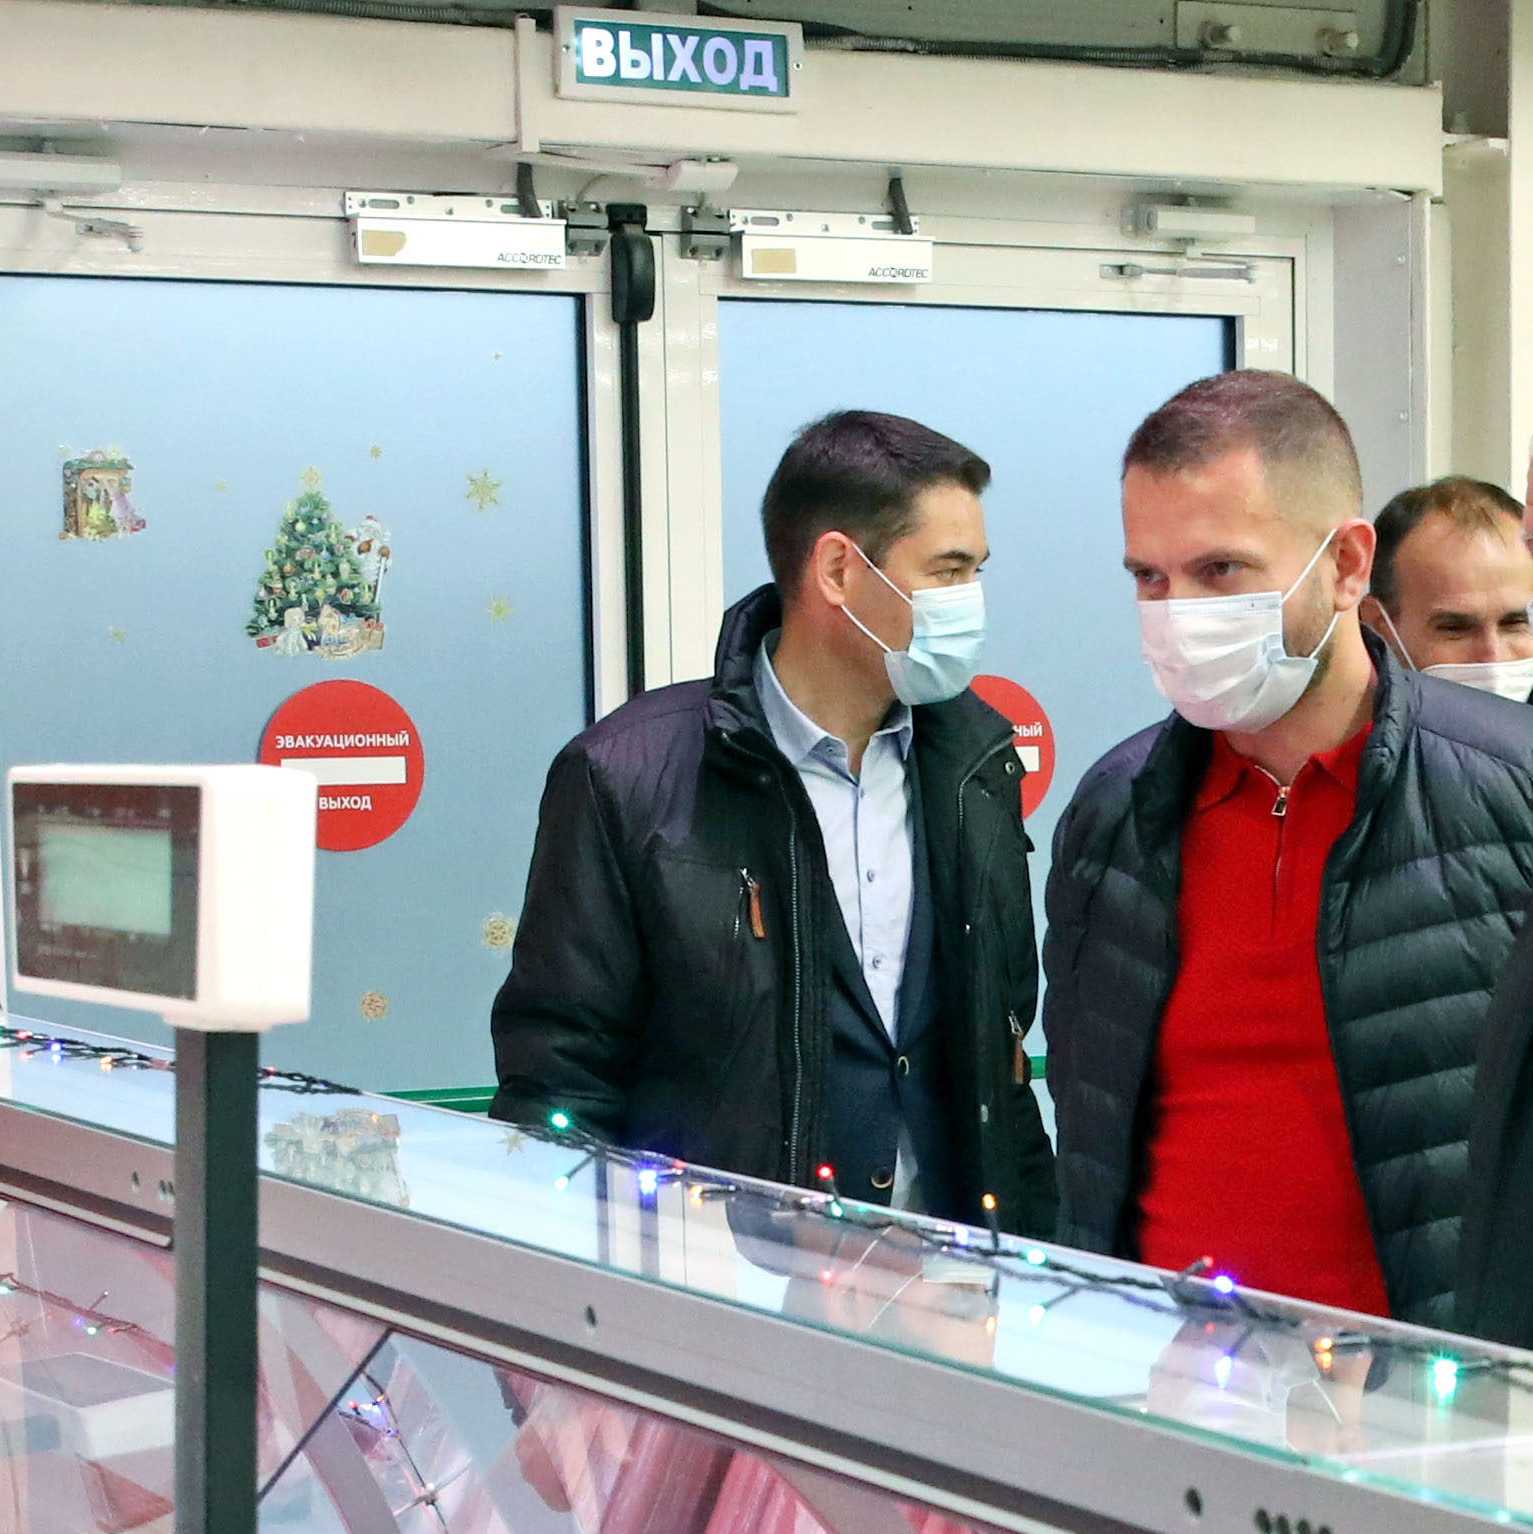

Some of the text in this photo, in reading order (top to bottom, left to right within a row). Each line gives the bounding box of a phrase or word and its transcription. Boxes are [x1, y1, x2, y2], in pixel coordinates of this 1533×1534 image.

[581, 27, 779, 92] ВЫХОД
[275, 730, 410, 750] ЭВАКУАЦИОННЫЙ
[318, 795, 373, 811] ВЫХОД
